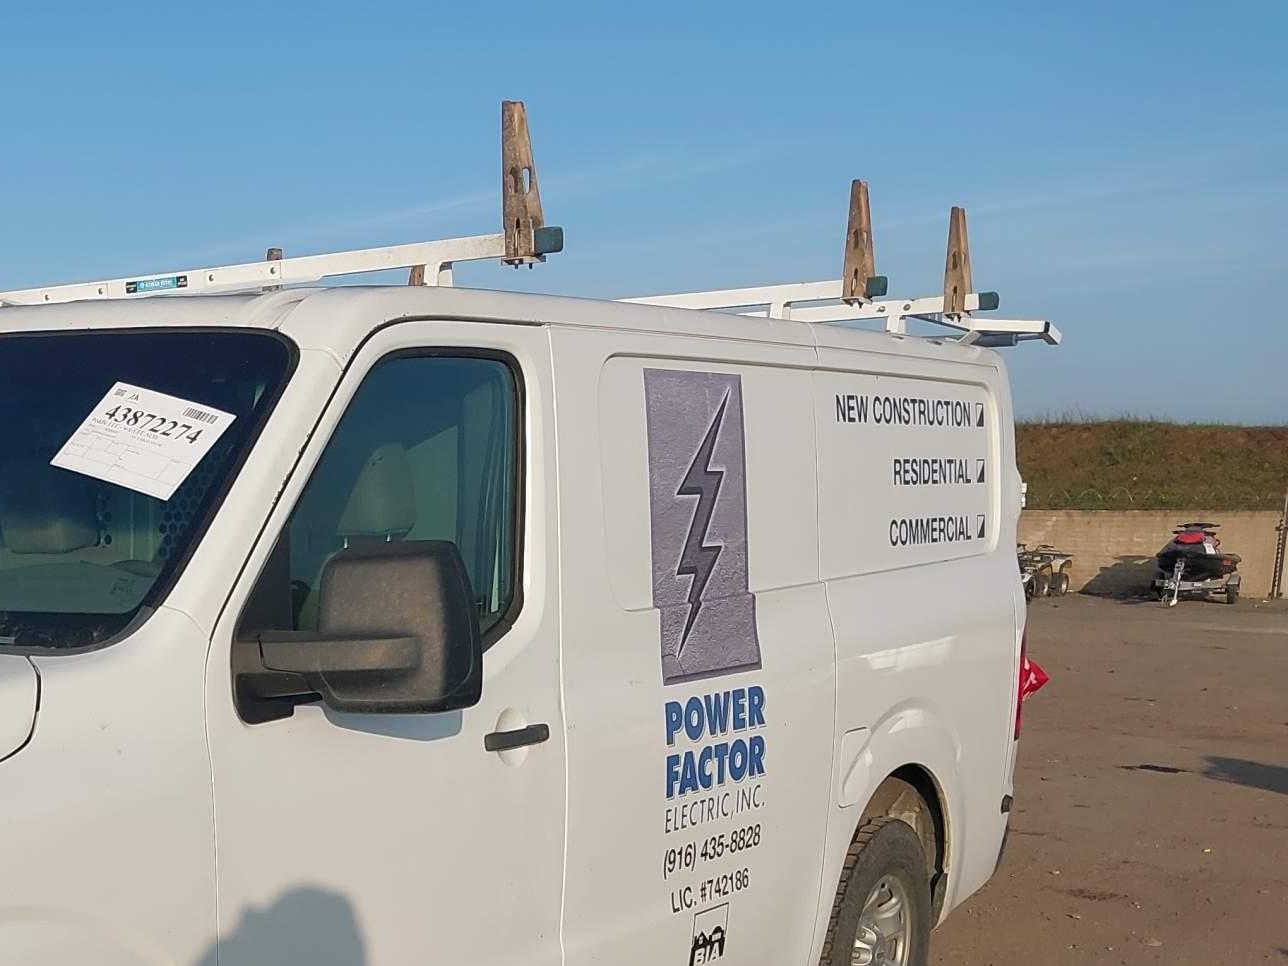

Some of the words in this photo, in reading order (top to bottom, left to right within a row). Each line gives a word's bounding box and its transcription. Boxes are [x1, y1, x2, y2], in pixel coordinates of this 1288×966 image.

[105, 404, 203, 444] 43872274
[836, 395, 868, 424] NEW
[873, 396, 971, 427] CONSTRUCTION
[893, 458, 972, 486] RESIDENTIAL
[890, 517, 972, 546] COMMERCIAL
[664, 685, 767, 746] POWER
[665, 735, 767, 799] FACTOR
[665, 792, 734, 834] ELECTRIC,
[736, 785, 765, 814] INC.
[663, 842, 697, 880] (916)
[700, 824, 761, 862] 435-8828
[671, 886, 697, 913] LIC.
[700, 868, 749, 902] #742186
